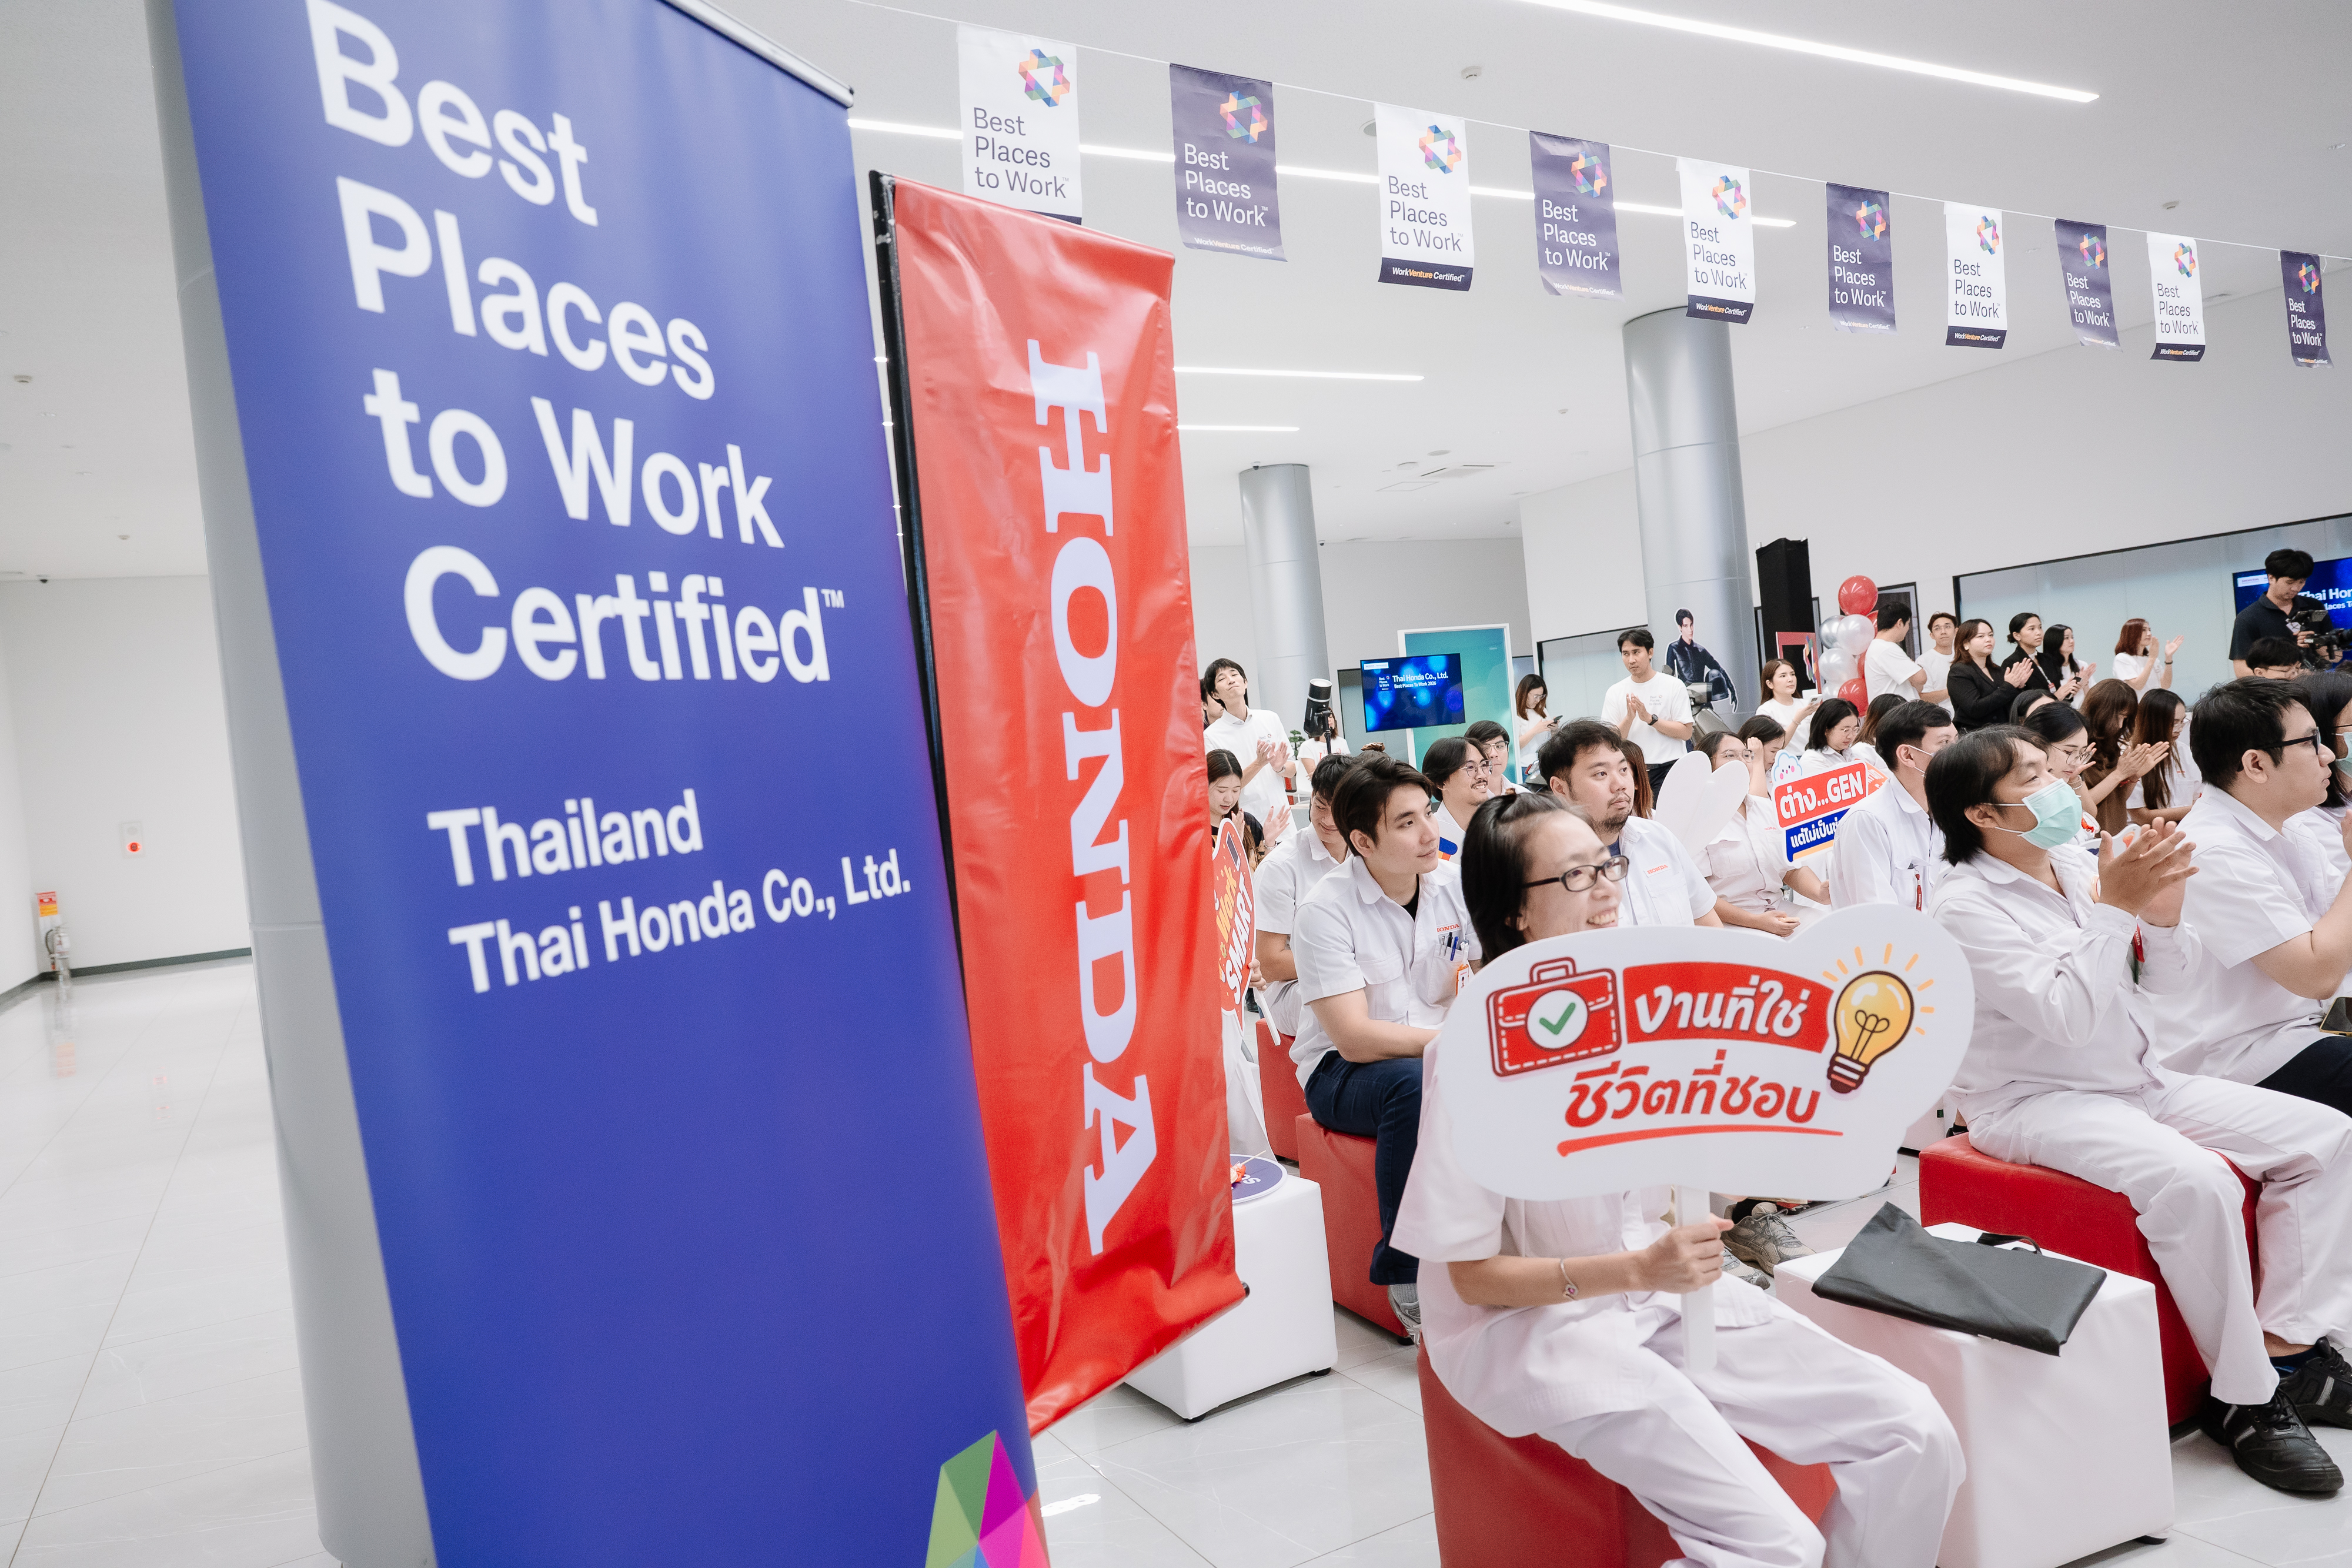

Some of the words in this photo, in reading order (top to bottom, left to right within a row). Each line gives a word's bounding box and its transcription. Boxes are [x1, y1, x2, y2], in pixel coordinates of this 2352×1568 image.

[306, 0, 597, 227] Best
[974, 107, 1026, 136] Best
[975, 136, 1050, 168] Places
[1184, 143, 1229, 170] Best
[975, 166, 999, 189] to
[1185, 170, 1251, 199] Places
[1389, 176, 1428, 200] Best
[1186, 197, 1207, 218] to
[1390, 200, 1447, 227] Places
[1543, 199, 1578, 222] Best
[1391, 226, 1409, 245] to
[1544, 223, 1596, 248] Places
[1690, 222, 1719, 243] Best
[1194, 238, 1240, 250] WorkVenture
[1545, 247, 1562, 265] to
[1693, 243, 1736, 266] Places
[1833, 245, 1861, 265] Best
[1392, 267, 1433, 279] WorkVenture
[1695, 267, 1708, 284] to
[1834, 266, 1875, 286] Places
[1954, 260, 1980, 276] Best
[336, 175, 715, 400] Places
[1553, 282, 1589, 292] WorkVenture
[1955, 279, 1992, 298] Places
[2066, 273, 2089, 290] Best
[2157, 283, 2180, 298] Best
[1835, 287, 1848, 304] to
[2070, 290, 2101, 309] Places
[2289, 298, 2306, 313] Best
[1696, 303, 1725, 313] WorkVenture
[1955, 299, 1969, 316] to
[2074, 309, 2084, 323] to
[2159, 301, 2190, 317] Places
[2160, 320, 2171, 333] to
[2291, 315, 2316, 330] Places
[2293, 332, 2301, 344] to
[363, 367, 507, 507] to
[530, 395, 785, 549] Work
[1027, 337, 1156, 1256] HONDA
[426, 788, 703, 887] Thailand
[1647, 864, 1668, 874] HONDA
[1217, 865, 1236, 941] Work
[447, 905, 589, 994] Thai
[598, 880, 756, 962] Honda
[763, 868, 836, 921] Co.,
[841, 848, 911, 905] Ltd.
[1225, 871, 1252, 1004] SMART
[1635, 974, 1811, 1037] งานที่ใช่
[1565, 1049, 1821, 1128] ชีวิตที่ชอบ
